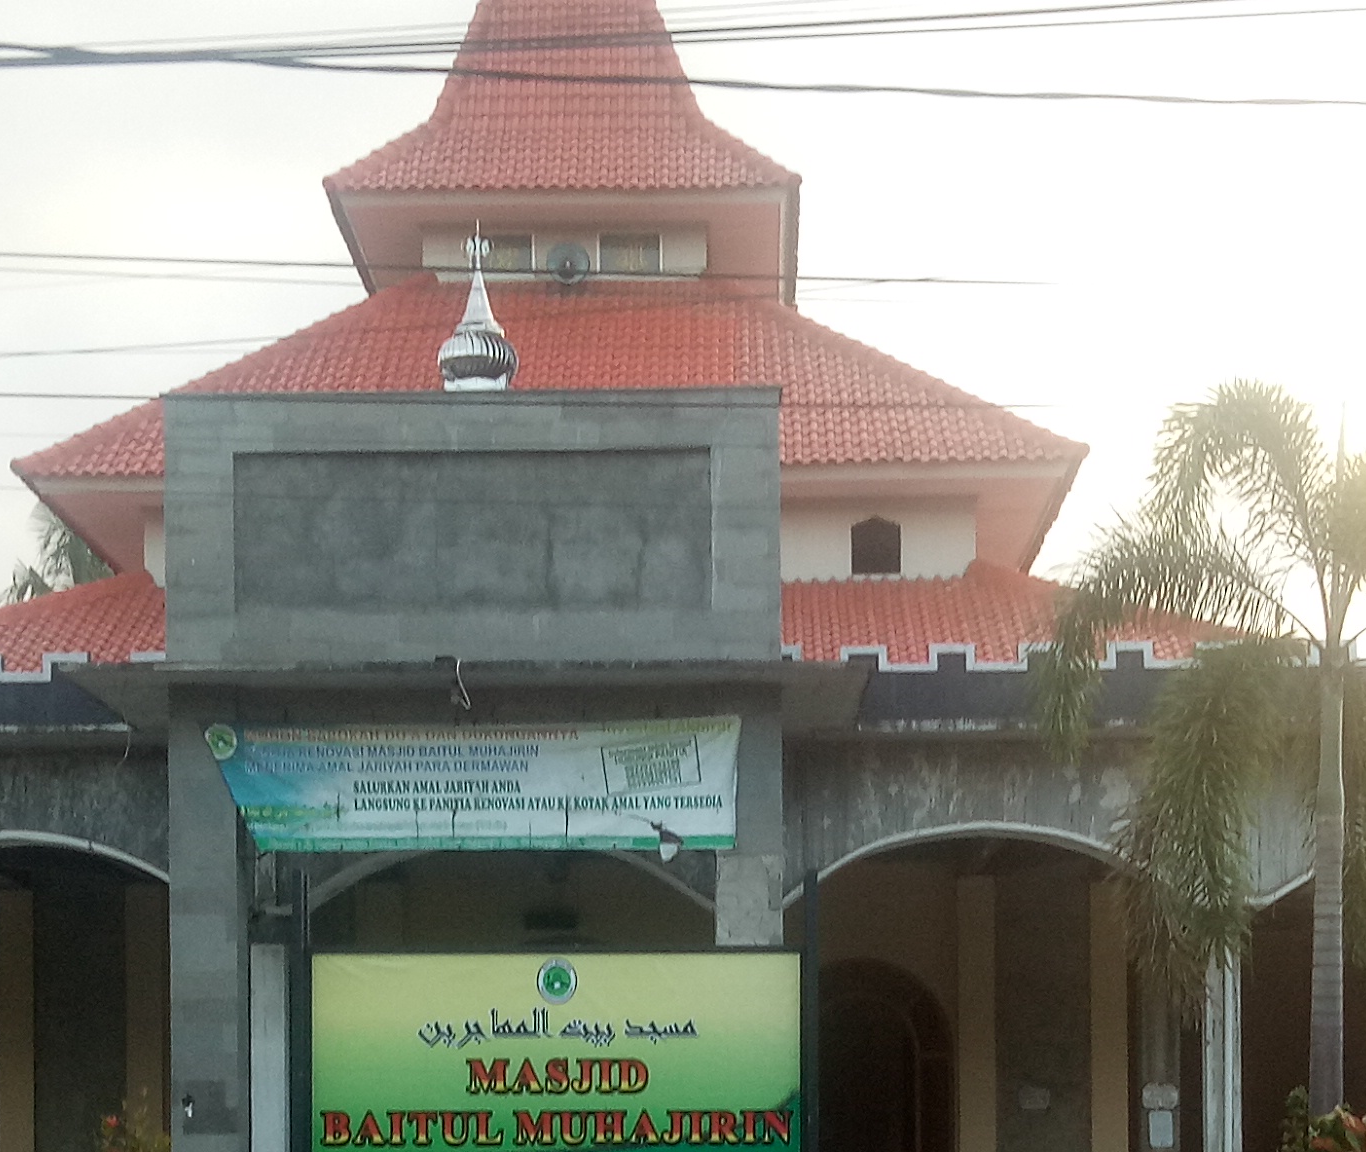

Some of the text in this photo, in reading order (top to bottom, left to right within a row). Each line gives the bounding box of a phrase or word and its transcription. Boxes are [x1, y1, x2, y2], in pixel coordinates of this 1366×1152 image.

[367, 745, 414, 758] MASJID
[419, 745, 462, 757] BAITUL
[469, 744, 539, 757] MUHAJIRIN
[319, 761, 352, 772] AMAL
[359, 761, 412, 773] JARIYAH
[416, 761, 450, 772] PARA
[454, 760, 529, 772] DERMAWAN
[353, 780, 521, 794] SALURKAN AMAL JARIYAH ANDA
[354, 797, 411, 811] LANGSUNG
[413, 797, 428, 811] KE
[430, 797, 471, 811] PANITIA
[474, 797, 525, 811] RENOVASI
[528, 797, 556, 811] ATAU
[574, 796, 608, 811] KOTAK
[611, 796, 641, 811] AMAL
[643, 796, 671, 810] YANG
[674, 795, 723, 810] TERSEDIA
[624, 1016, 699, 1046] مسجد
[466, 1057, 650, 1095] MASJID
[320, 1108, 795, 1147] BAITUL MUHAJIRIN
